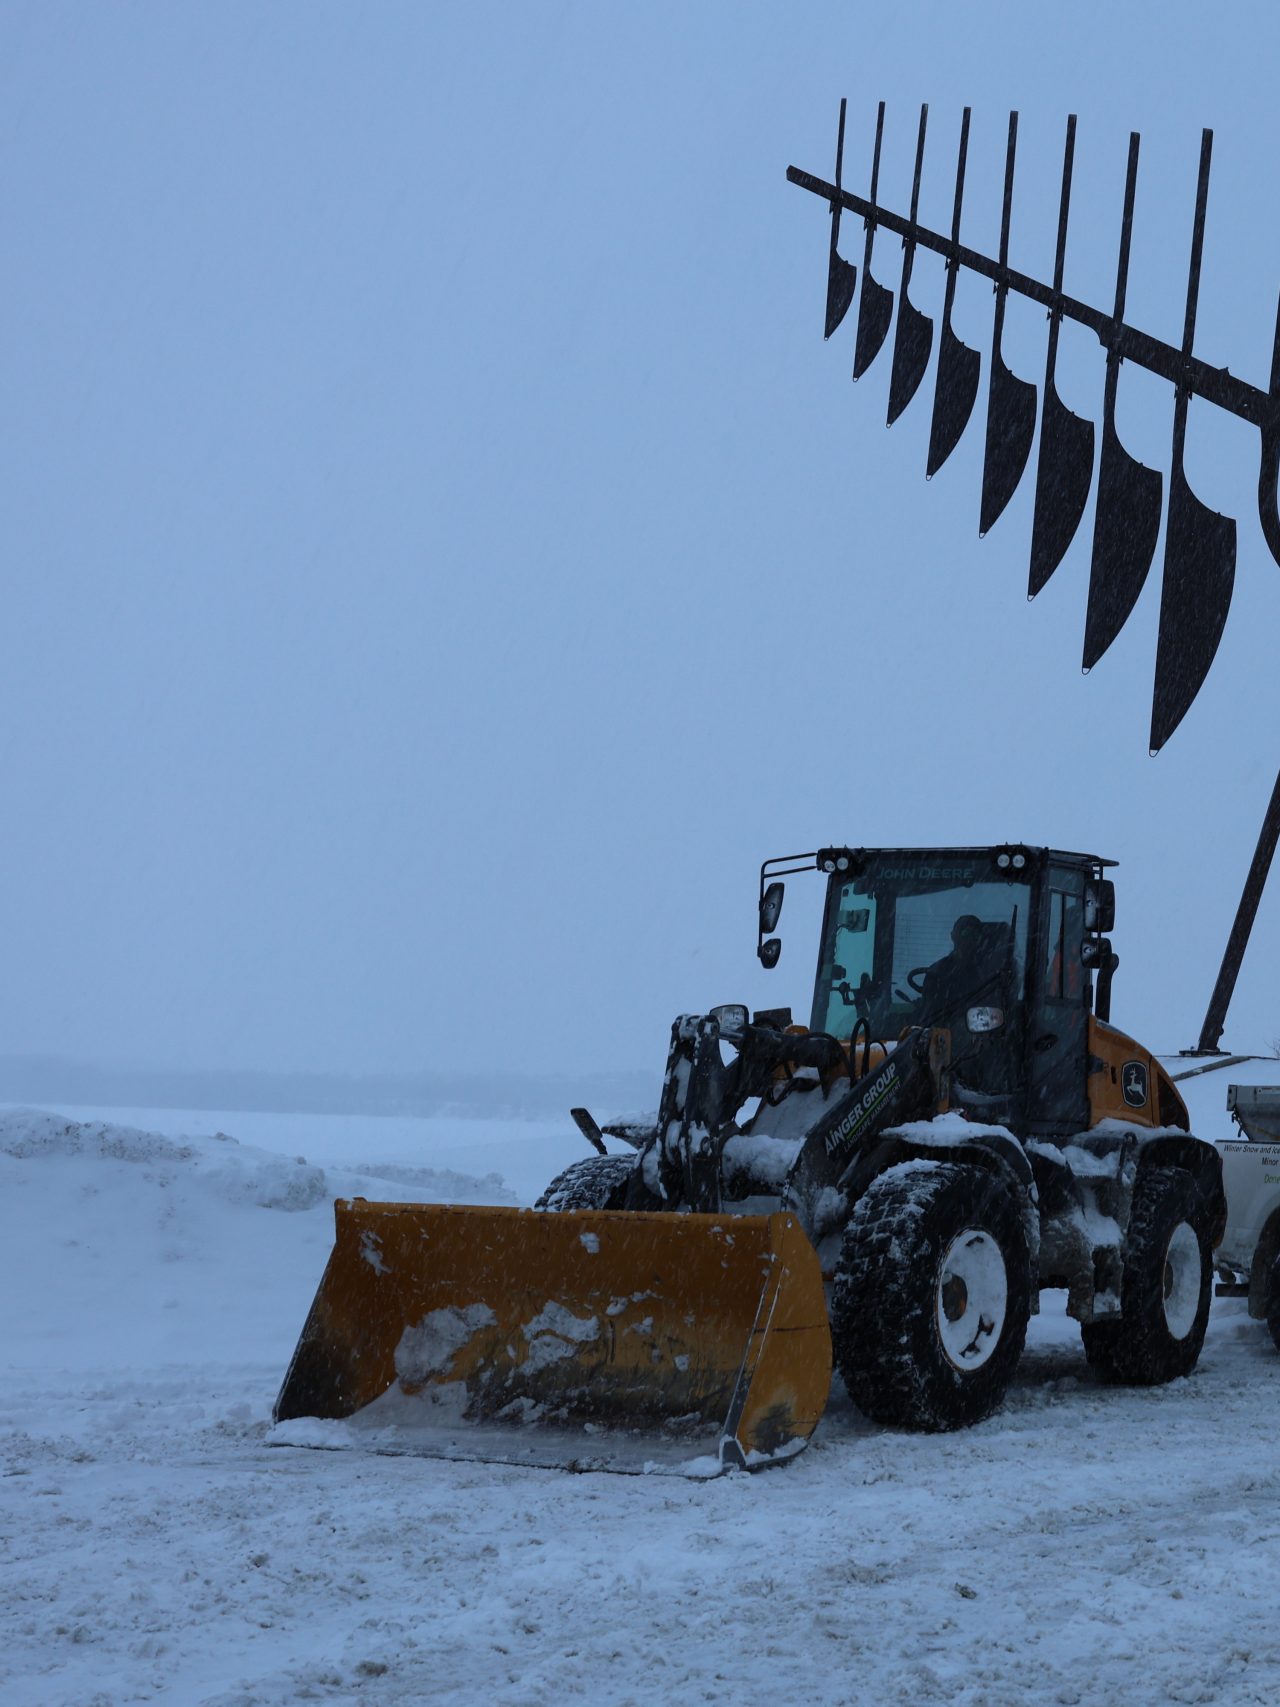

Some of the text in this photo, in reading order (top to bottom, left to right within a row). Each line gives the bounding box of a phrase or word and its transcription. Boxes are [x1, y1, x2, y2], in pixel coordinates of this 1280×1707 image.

[876, 866, 974, 880] JOHN DEERE
[863, 1062, 896, 1108] GROUP
[1224, 1144, 1241, 1153] Winter
[1243, 1145, 1259, 1153] Snow
[1259, 1145, 1271, 1154] and
[1261, 1157, 1278, 1166] Minor
[1264, 1174, 1280, 1184] Done
